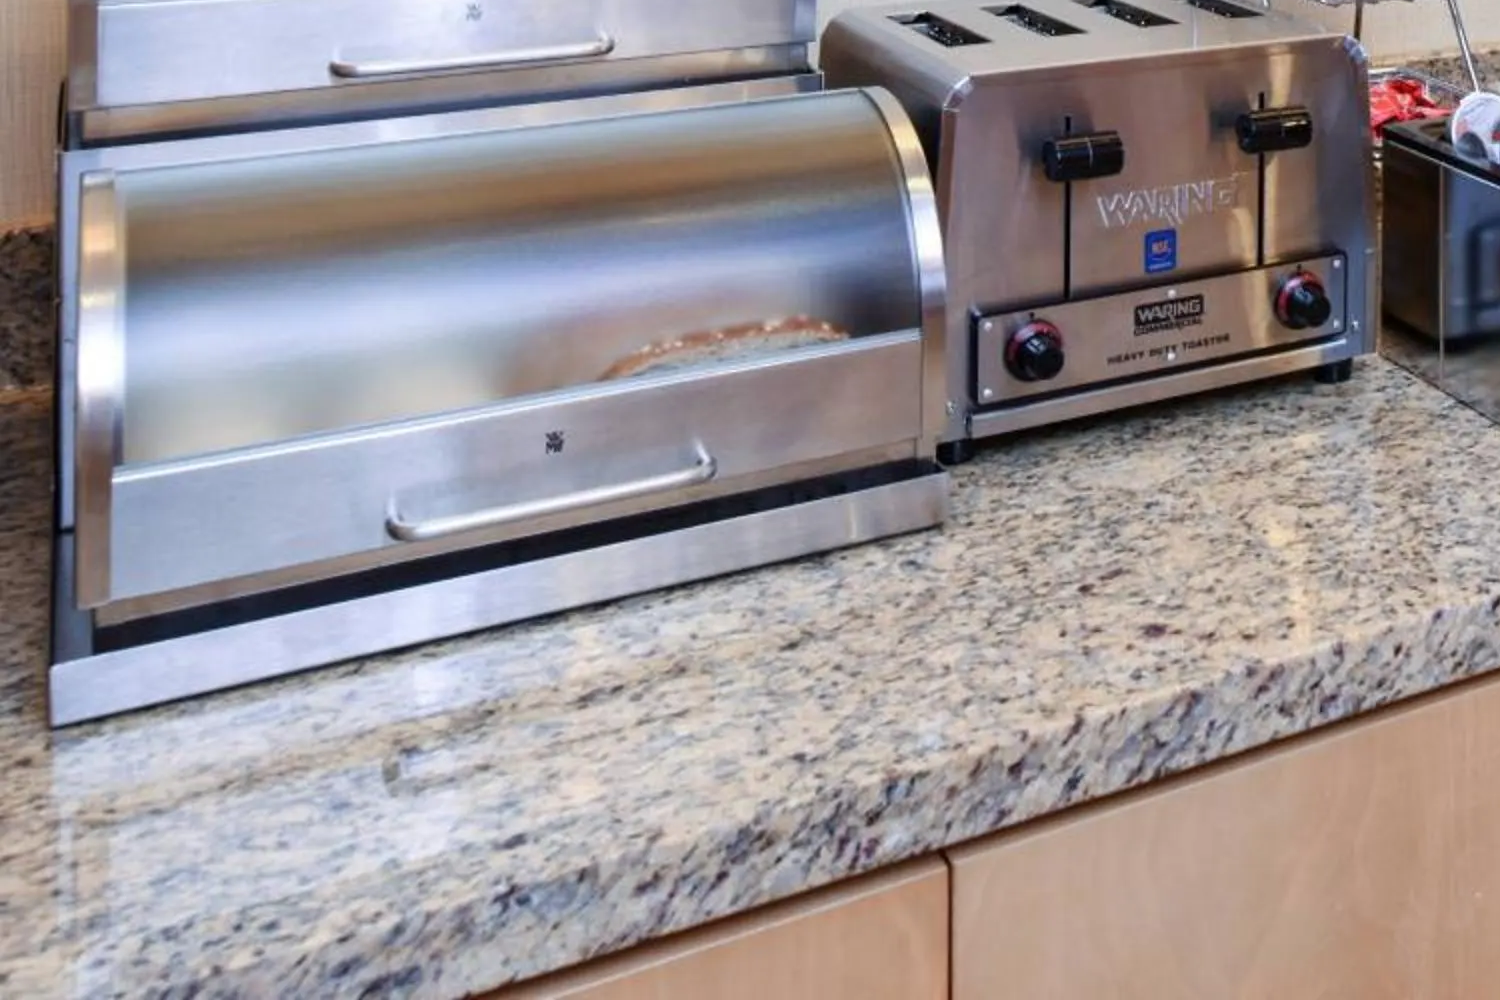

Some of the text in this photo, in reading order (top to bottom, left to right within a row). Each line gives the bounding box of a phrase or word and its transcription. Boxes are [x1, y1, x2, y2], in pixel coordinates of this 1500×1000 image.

[1096, 176, 1235, 228] WARING
[1137, 299, 1201, 324] WARING
[1107, 350, 1145, 364] HEAVY
[1149, 344, 1177, 357] DUTY
